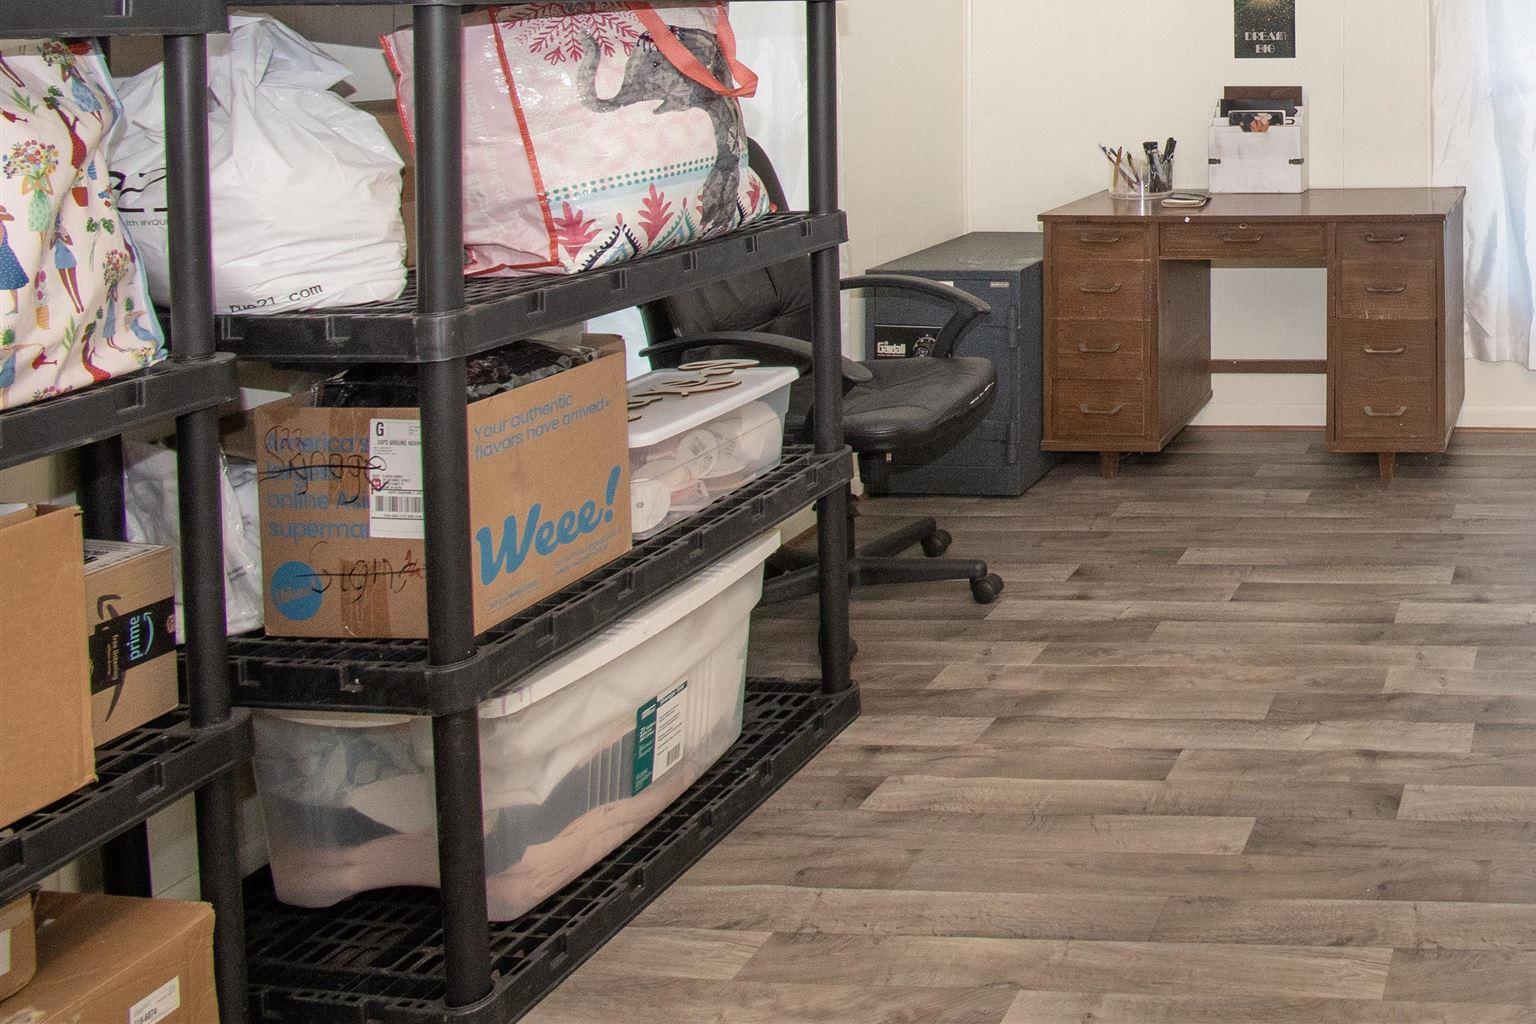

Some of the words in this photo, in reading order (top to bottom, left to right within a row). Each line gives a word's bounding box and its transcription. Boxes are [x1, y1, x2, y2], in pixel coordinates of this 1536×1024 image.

[1244, 31, 1287, 41] DREAM
[1255, 44, 1276, 54] BIG
[376, 421, 385, 437] G
[474, 419, 507, 441] Your
[509, 393, 573, 428] authentic
[475, 430, 524, 460] flavors
[527, 417, 560, 440] have
[476, 465, 622, 587] Weee!
[126, 615, 144, 661] prime
